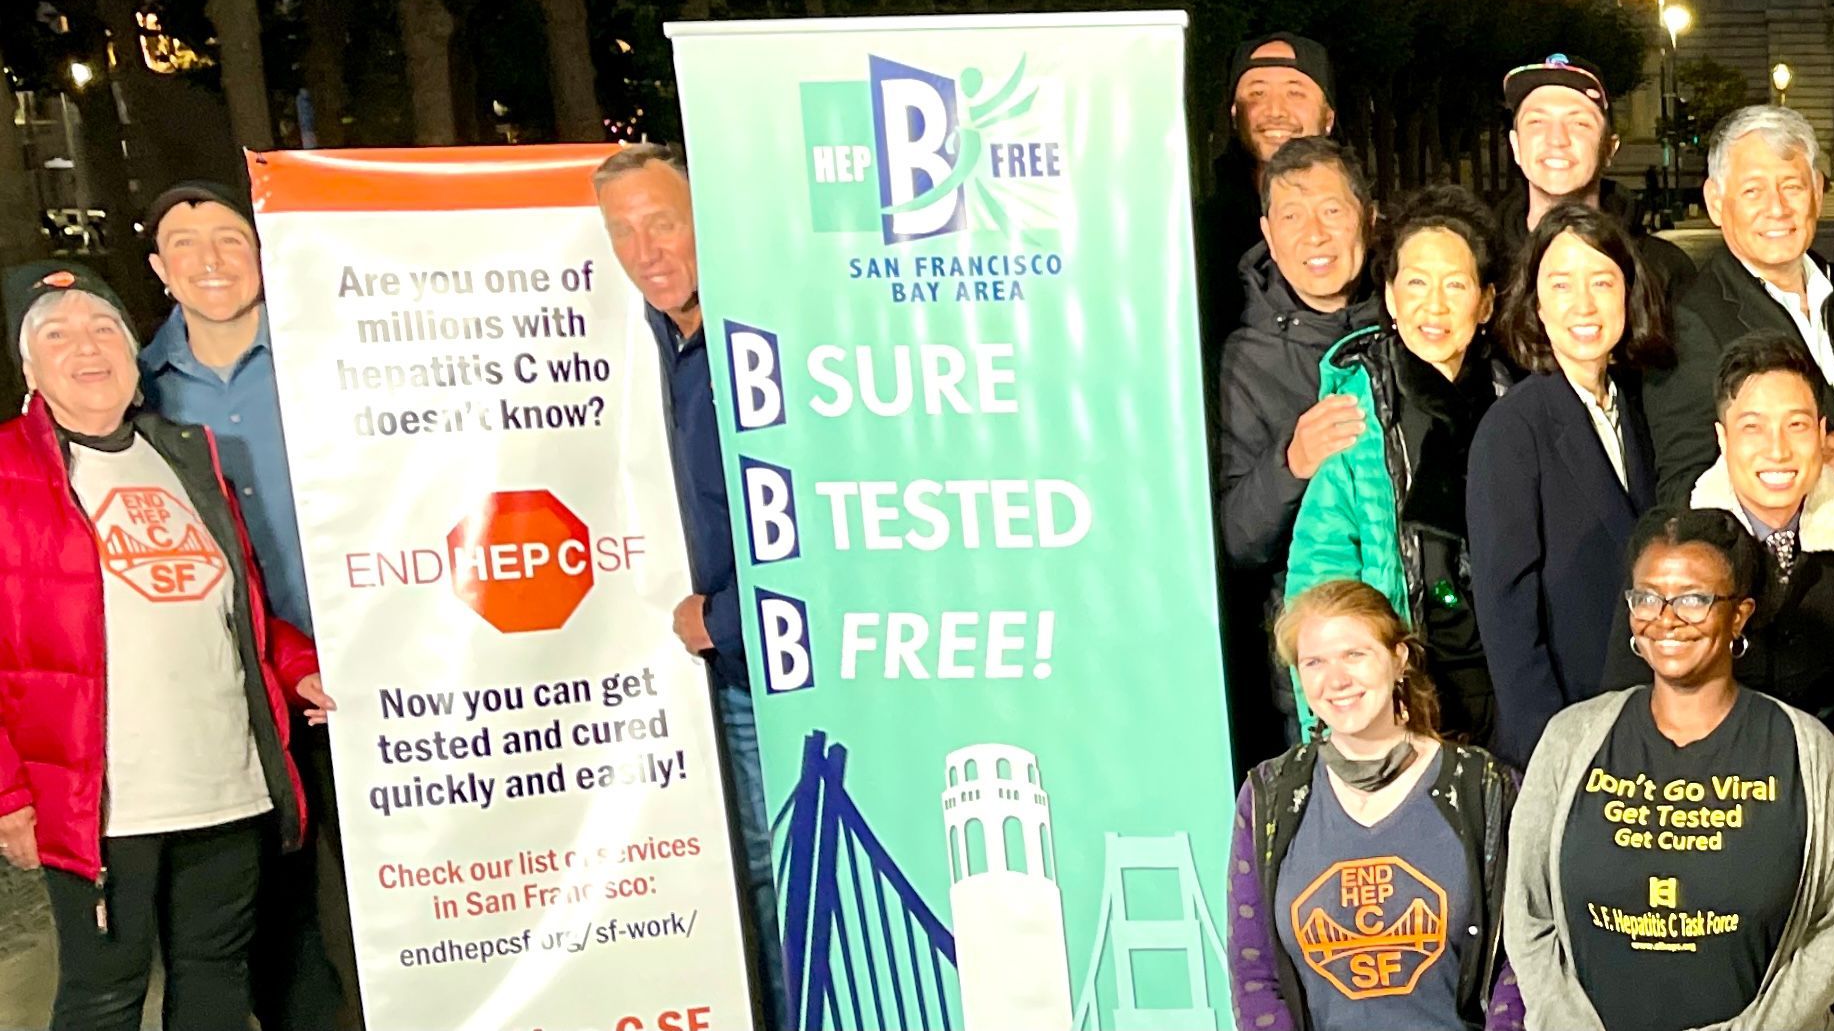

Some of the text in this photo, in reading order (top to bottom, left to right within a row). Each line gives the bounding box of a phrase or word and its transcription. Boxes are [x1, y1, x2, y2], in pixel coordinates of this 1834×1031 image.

[813, 78, 1061, 235] HEP B FREE
[338, 260, 594, 302] Are you one of
[849, 254, 1062, 279] SAN FRANCISCO
[892, 280, 1025, 303] BAY AREA
[357, 306, 586, 343] millions with
[336, 352, 610, 394] hepatitis C who
[730, 331, 1018, 428] B SURE
[500, 396, 605, 430] know?
[122, 493, 164, 508] END
[129, 509, 171, 525] HEP
[745, 467, 1092, 562] B TESTED
[147, 525, 173, 548] C
[150, 564, 196, 594] SF
[346, 536, 646, 588] END HEP C SF
[760, 598, 1055, 692] B FREE!
[379, 667, 658, 721] Now you can get
[377, 708, 669, 764] tested and cured
[369, 750, 687, 817] quickly and easily!
[1585, 768, 1776, 802] Don't Go Viral
[1604, 800, 1742, 829] Get Tested
[1614, 828, 1723, 851] Get Cured
[379, 860, 463, 889] Check
[470, 857, 513, 882] our
[520, 849, 559, 875] list
[1341, 865, 1393, 887] END
[433, 896, 458, 920] in
[466, 890, 516, 916] San
[1341, 883, 1394, 907] HEP
[1355, 904, 1384, 935] C
[1612, 908, 1667, 940] Hepatitis
[1668, 913, 1678, 938] C
[1679, 910, 1705, 937] Task
[1706, 911, 1740, 935] Force
[1350, 951, 1401, 988] SF
